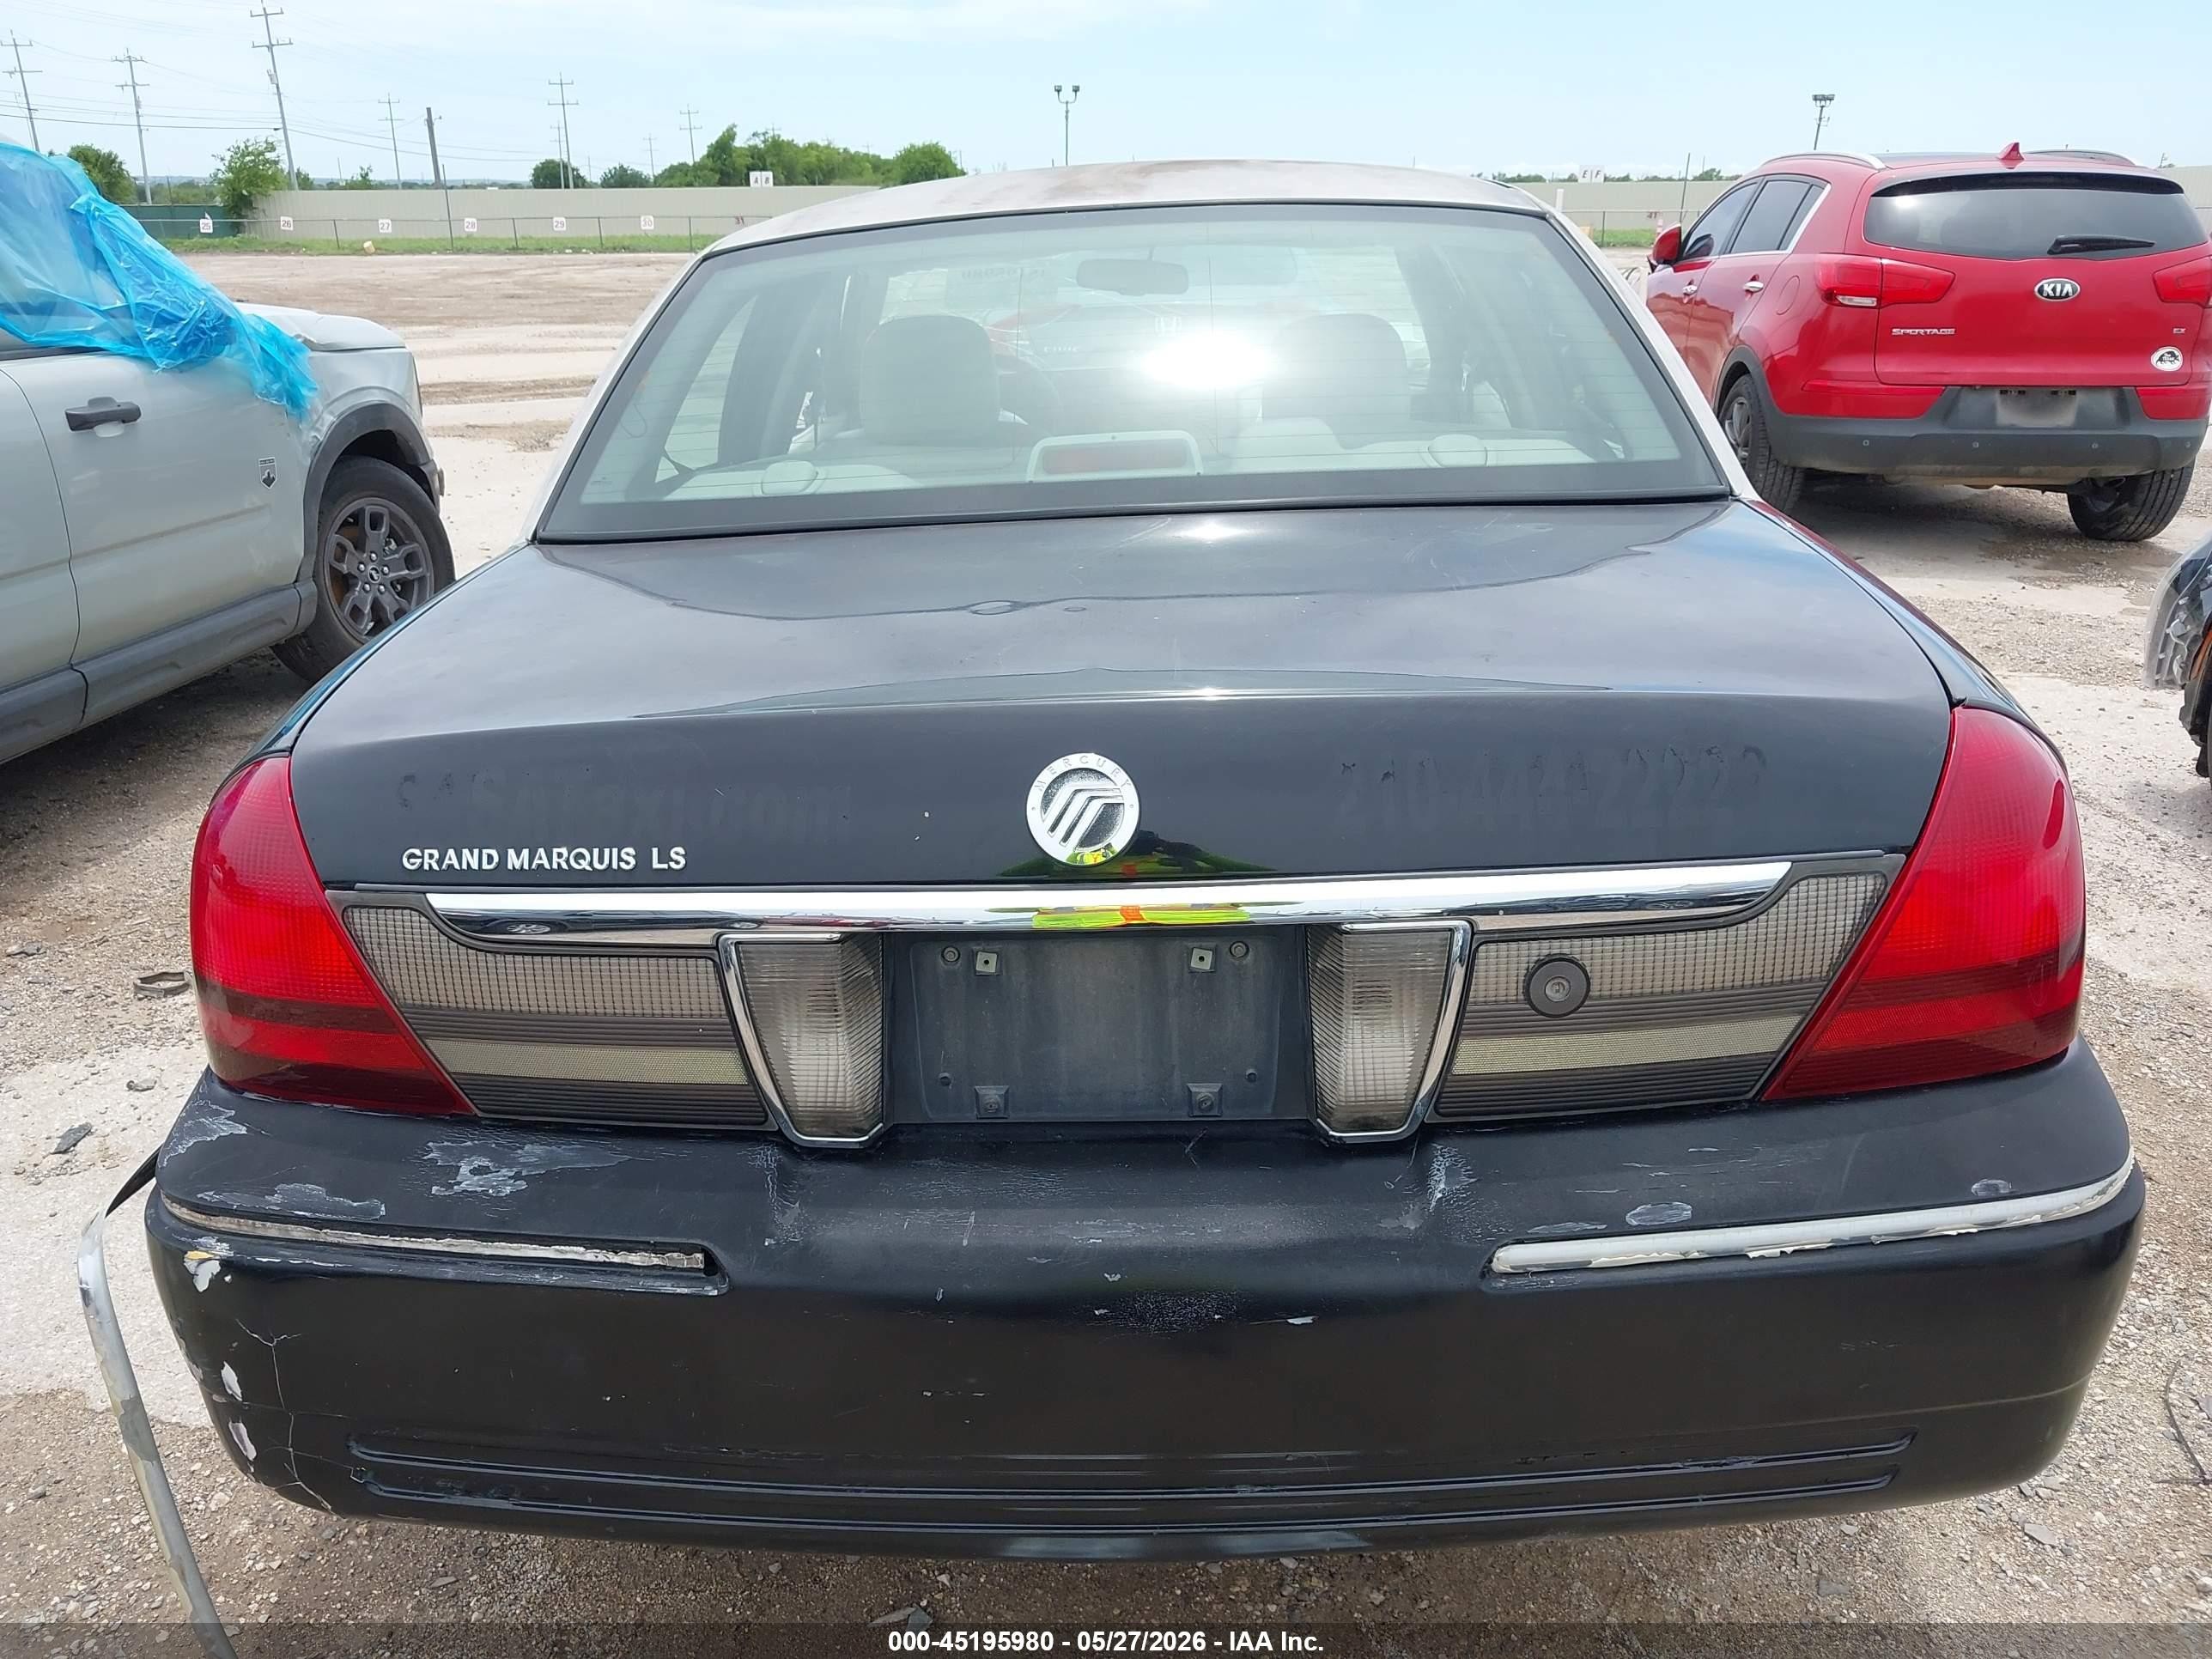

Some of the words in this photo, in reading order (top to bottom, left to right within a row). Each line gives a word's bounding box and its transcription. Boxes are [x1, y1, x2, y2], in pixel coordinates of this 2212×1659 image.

[201, 222, 211, 231] 25
[282, 220, 292, 228] 26
[380, 222, 390, 231] 27
[465, 221, 476, 229] 28
[555, 220, 565, 228] 29
[2043, 283, 2073, 296] KIA
[1034, 755, 1132, 793] MERCURY
[402, 848, 499, 871] GRAND
[507, 847, 636, 872] MARQUIS
[652, 847, 686, 871] LS
